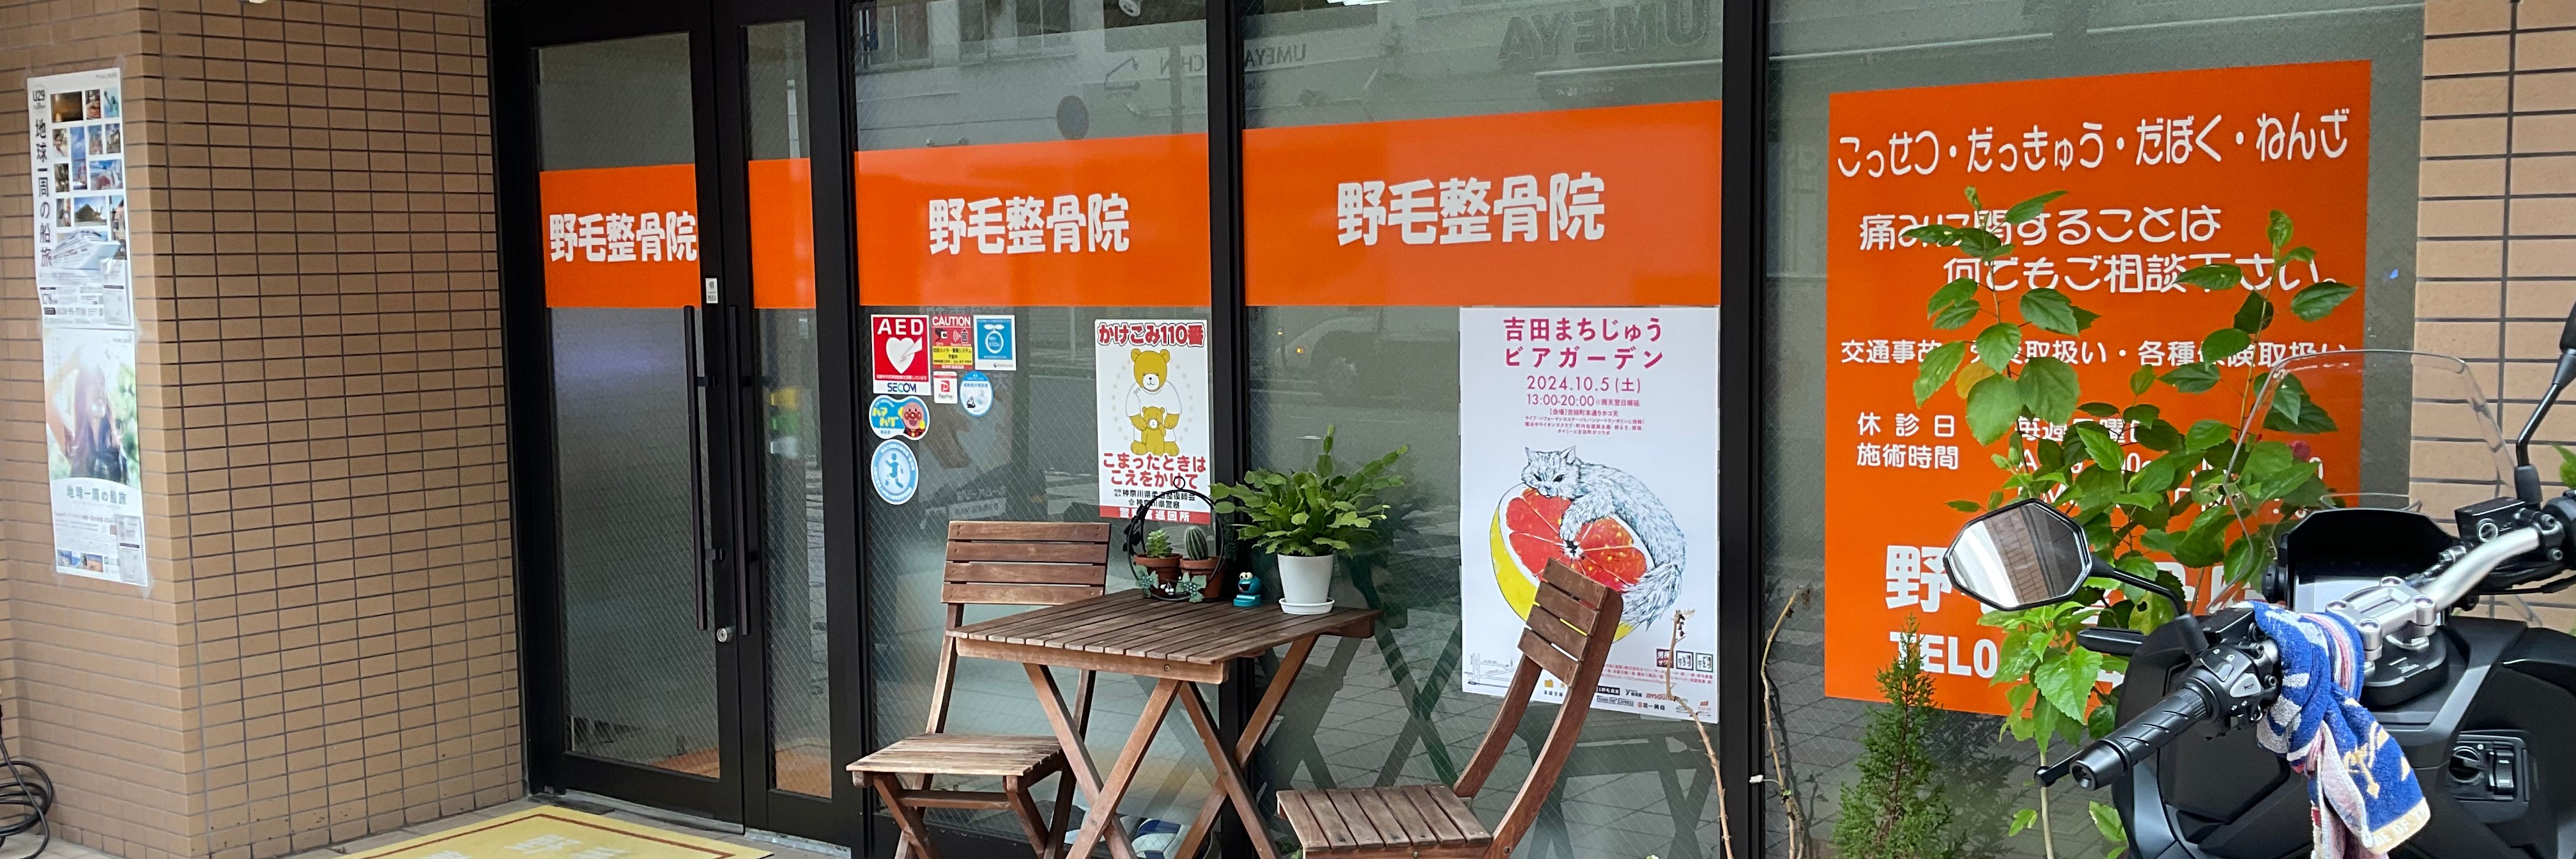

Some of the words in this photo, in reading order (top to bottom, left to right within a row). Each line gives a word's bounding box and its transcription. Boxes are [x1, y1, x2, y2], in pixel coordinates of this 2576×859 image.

[1837, 108, 2350, 178] こっせつ・だっきゅう・だぼく・ねんざ
[34, 118, 52, 267] 地球一周の船旅
[1337, 172, 1606, 247] 野毛整骨院
[549, 210, 697, 263] 野毛整骨院
[929, 193, 1130, 256] 野毛整骨院
[877, 318, 924, 335] AED
[932, 316, 970, 326] CAUTION
[1503, 316, 1662, 342] 吉田まちじゅう
[1098, 323, 1204, 346] かけこみ110番
[1505, 346, 1663, 370] ビアガーデン
[887, 382, 917, 392] SECOM
[1527, 375, 1609, 392] 2024.10.5
[1103, 452, 1206, 473] こまったときは
[1857, 442, 1959, 470] 施術時間
[1111, 470, 1198, 489] こえをかけて
